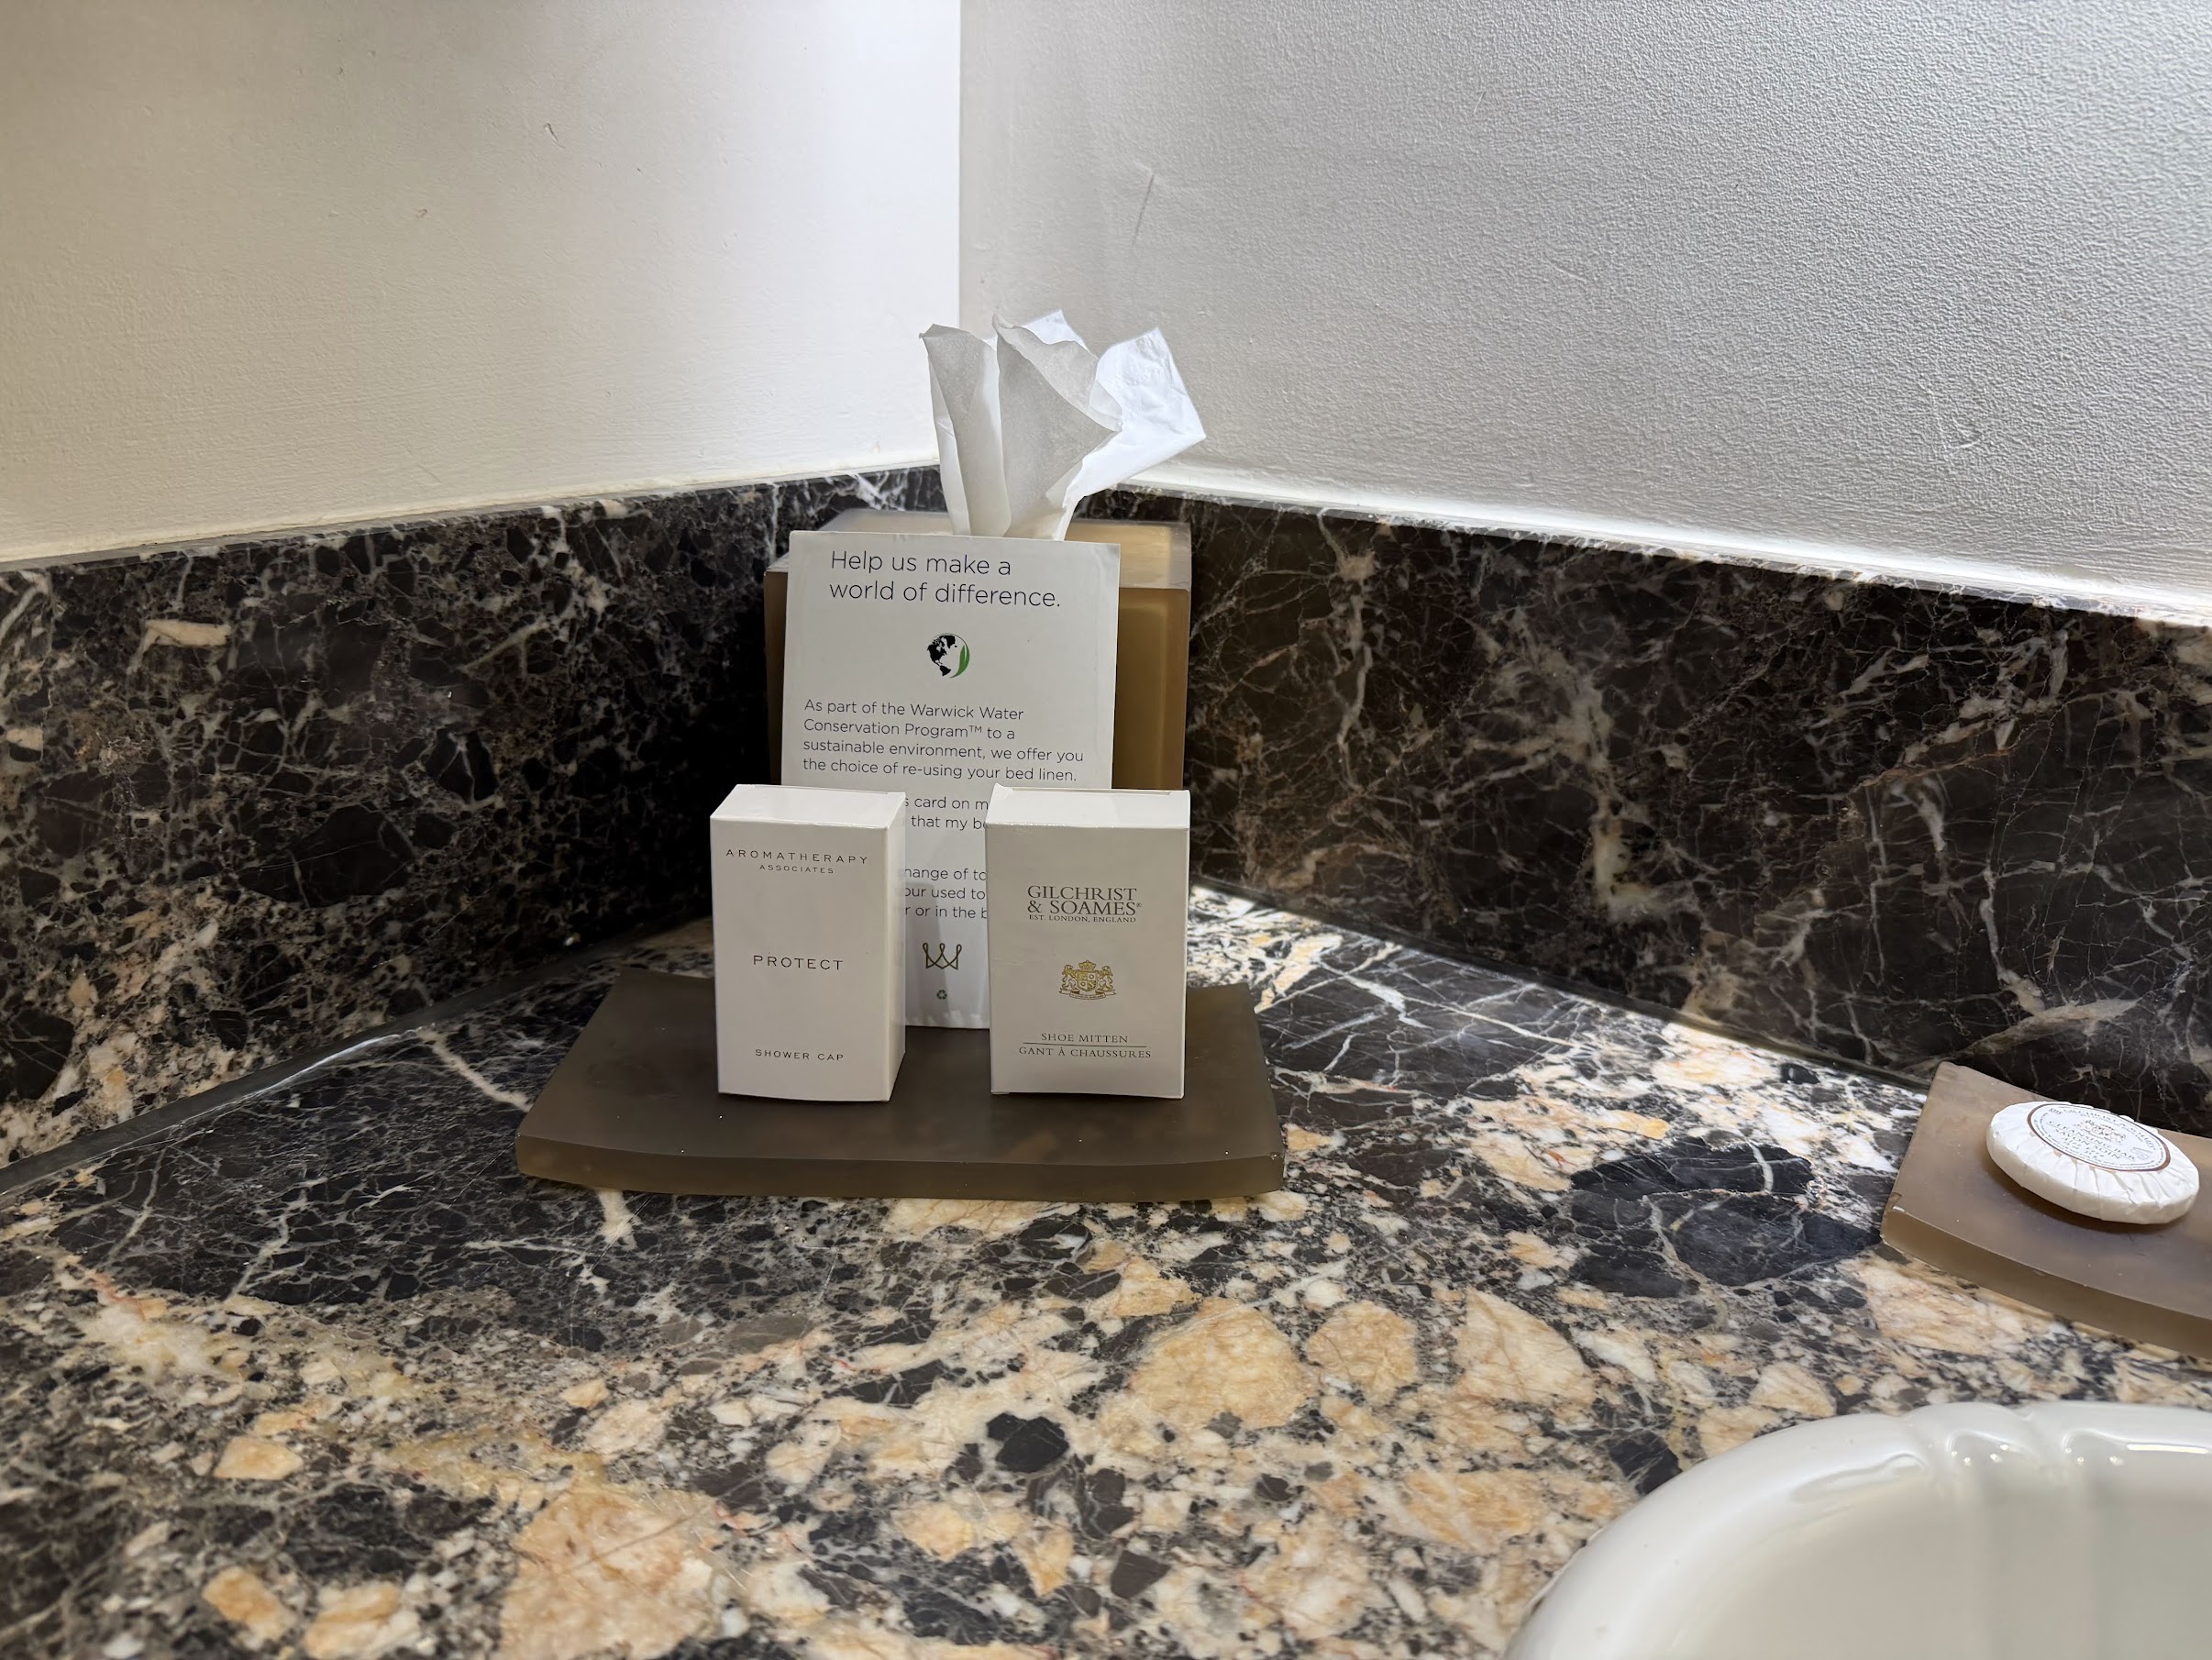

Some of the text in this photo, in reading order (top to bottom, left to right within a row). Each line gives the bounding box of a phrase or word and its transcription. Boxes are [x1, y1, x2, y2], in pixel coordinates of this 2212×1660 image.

[832, 551, 1010, 575] Help us make a
[830, 581, 1059, 606] world of difference.
[804, 700, 1023, 719] As part of the Warwick Water
[804, 719, 899, 734] Conservation
[987, 727, 1001, 738] to
[1007, 731, 1014, 739] a
[803, 740, 1083, 763] sustainable environment, we offer you
[803, 758, 1076, 780] the choice of re-using your bed linen.
[914, 797, 946, 808] card
[952, 801, 969, 809] on
[912, 815, 940, 827] that
[946, 820, 968, 831] my
[726, 848, 868, 864] AROMATHERAPY
[759, 865, 833, 873] ASSOCIATES
[905, 869, 948, 880] hange
[954, 869, 968, 880] of
[905, 888, 925, 897] our
[932, 888, 965, 899] used
[1027, 885, 1137, 901] GILCHRIST
[915, 908, 930, 916] or
[935, 905, 946, 917] in
[953, 907, 976, 918] the
[1027, 901, 1043, 914] &
[1049, 915, 1090, 924] LONDON,
[754, 956, 843, 969] PROTECT
[1041, 1033, 1128, 1044] SHOE MITTEN
[756, 1049, 809, 1059] SHOWER
[1019, 1046, 1054, 1056] GANT
[1057, 1046, 1067, 1057] À
[2055, 1129, 2090, 1145] SAVON
[2092, 1145, 2121, 1159] SOIN
[2114, 1148, 2135, 1161] BAR
